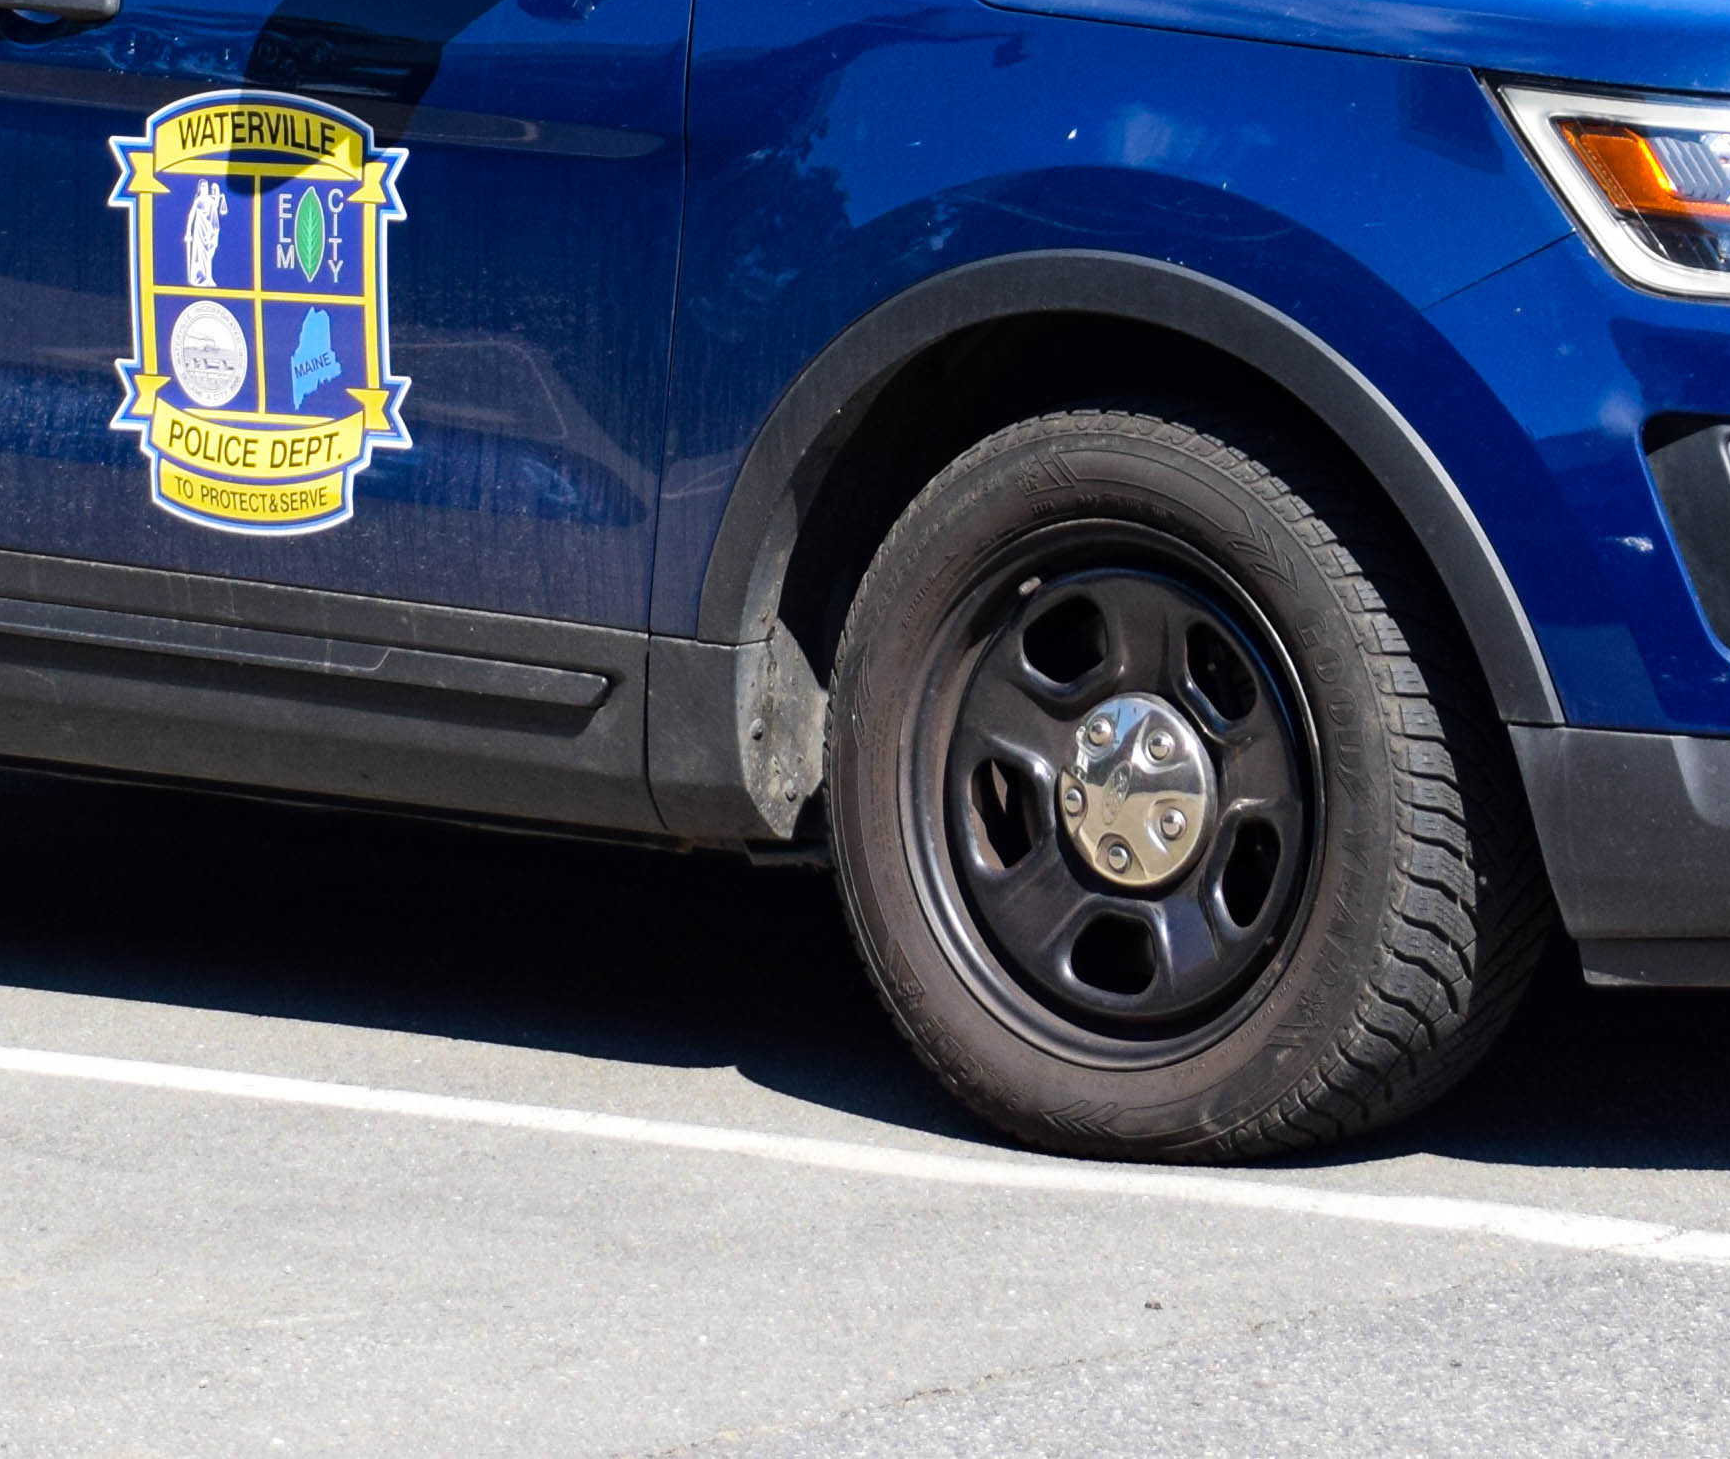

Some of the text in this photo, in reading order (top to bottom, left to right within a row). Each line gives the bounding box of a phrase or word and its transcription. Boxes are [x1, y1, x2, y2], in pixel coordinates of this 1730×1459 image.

[178, 110, 336, 158] WATERVILLE
[276, 193, 295, 269] ELM
[327, 188, 344, 283] CITY
[294, 351, 332, 379] MAINE
[168, 419, 343, 469] POLICE DEPT.
[174, 475, 328, 513] TO PROTECT&SERVE
